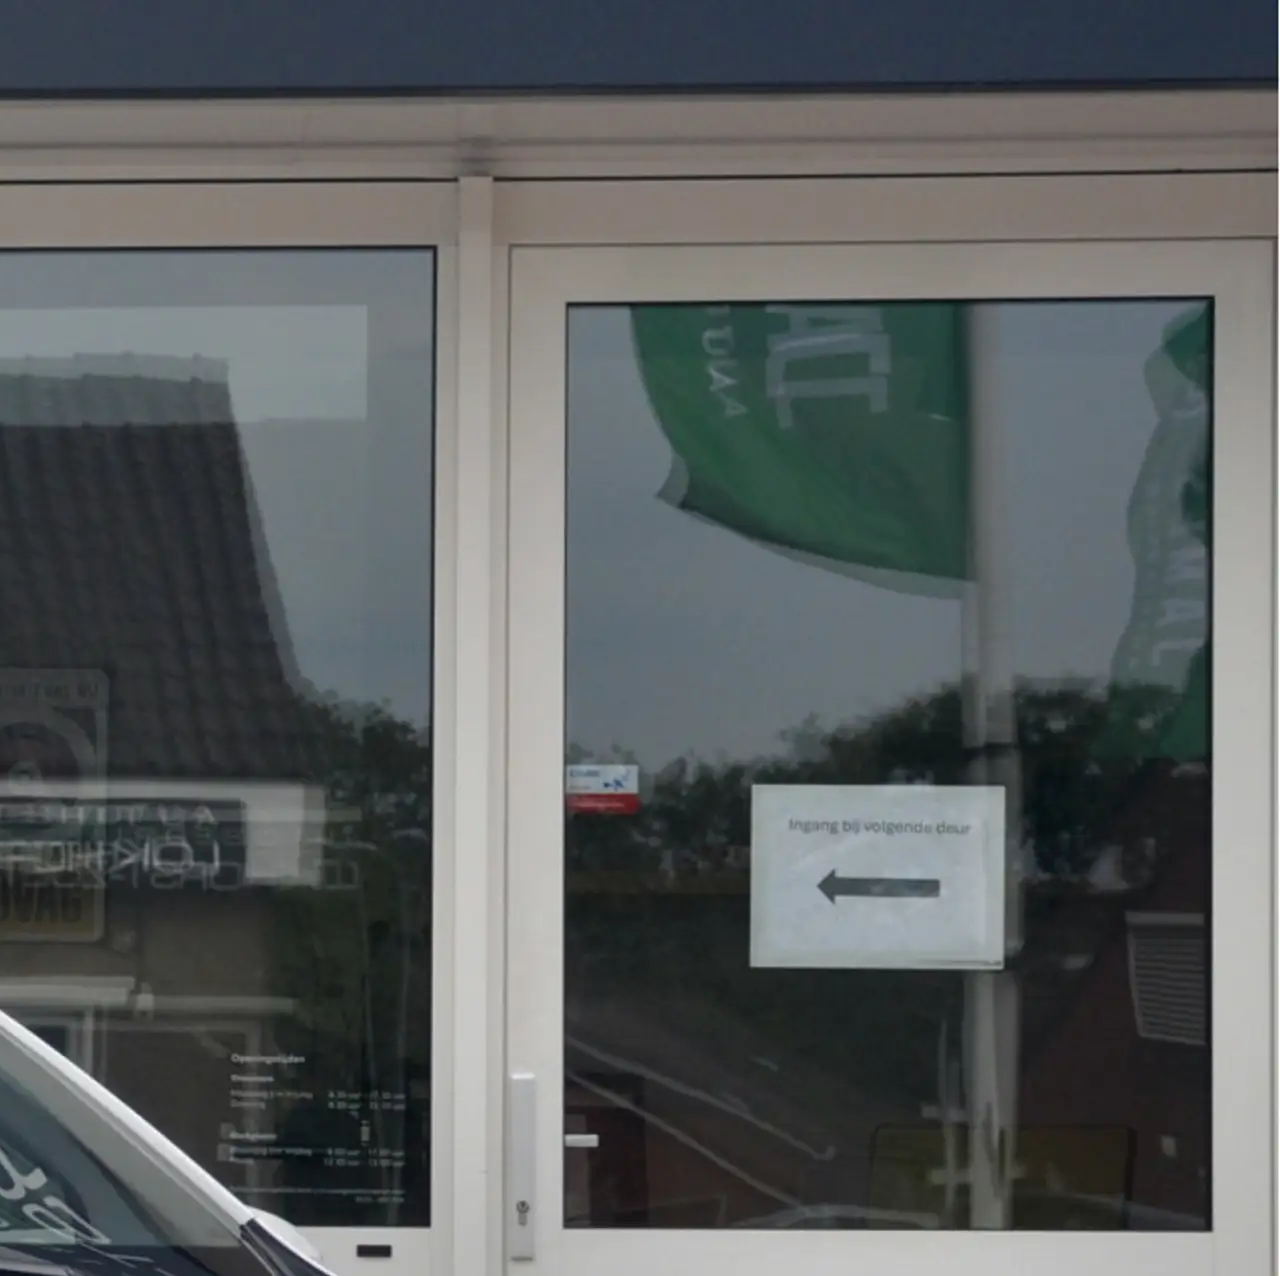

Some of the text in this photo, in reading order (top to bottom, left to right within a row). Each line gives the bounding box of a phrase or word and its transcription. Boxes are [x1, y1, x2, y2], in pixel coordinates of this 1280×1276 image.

[788, 818, 971, 836] Ingang bij volgende deur
